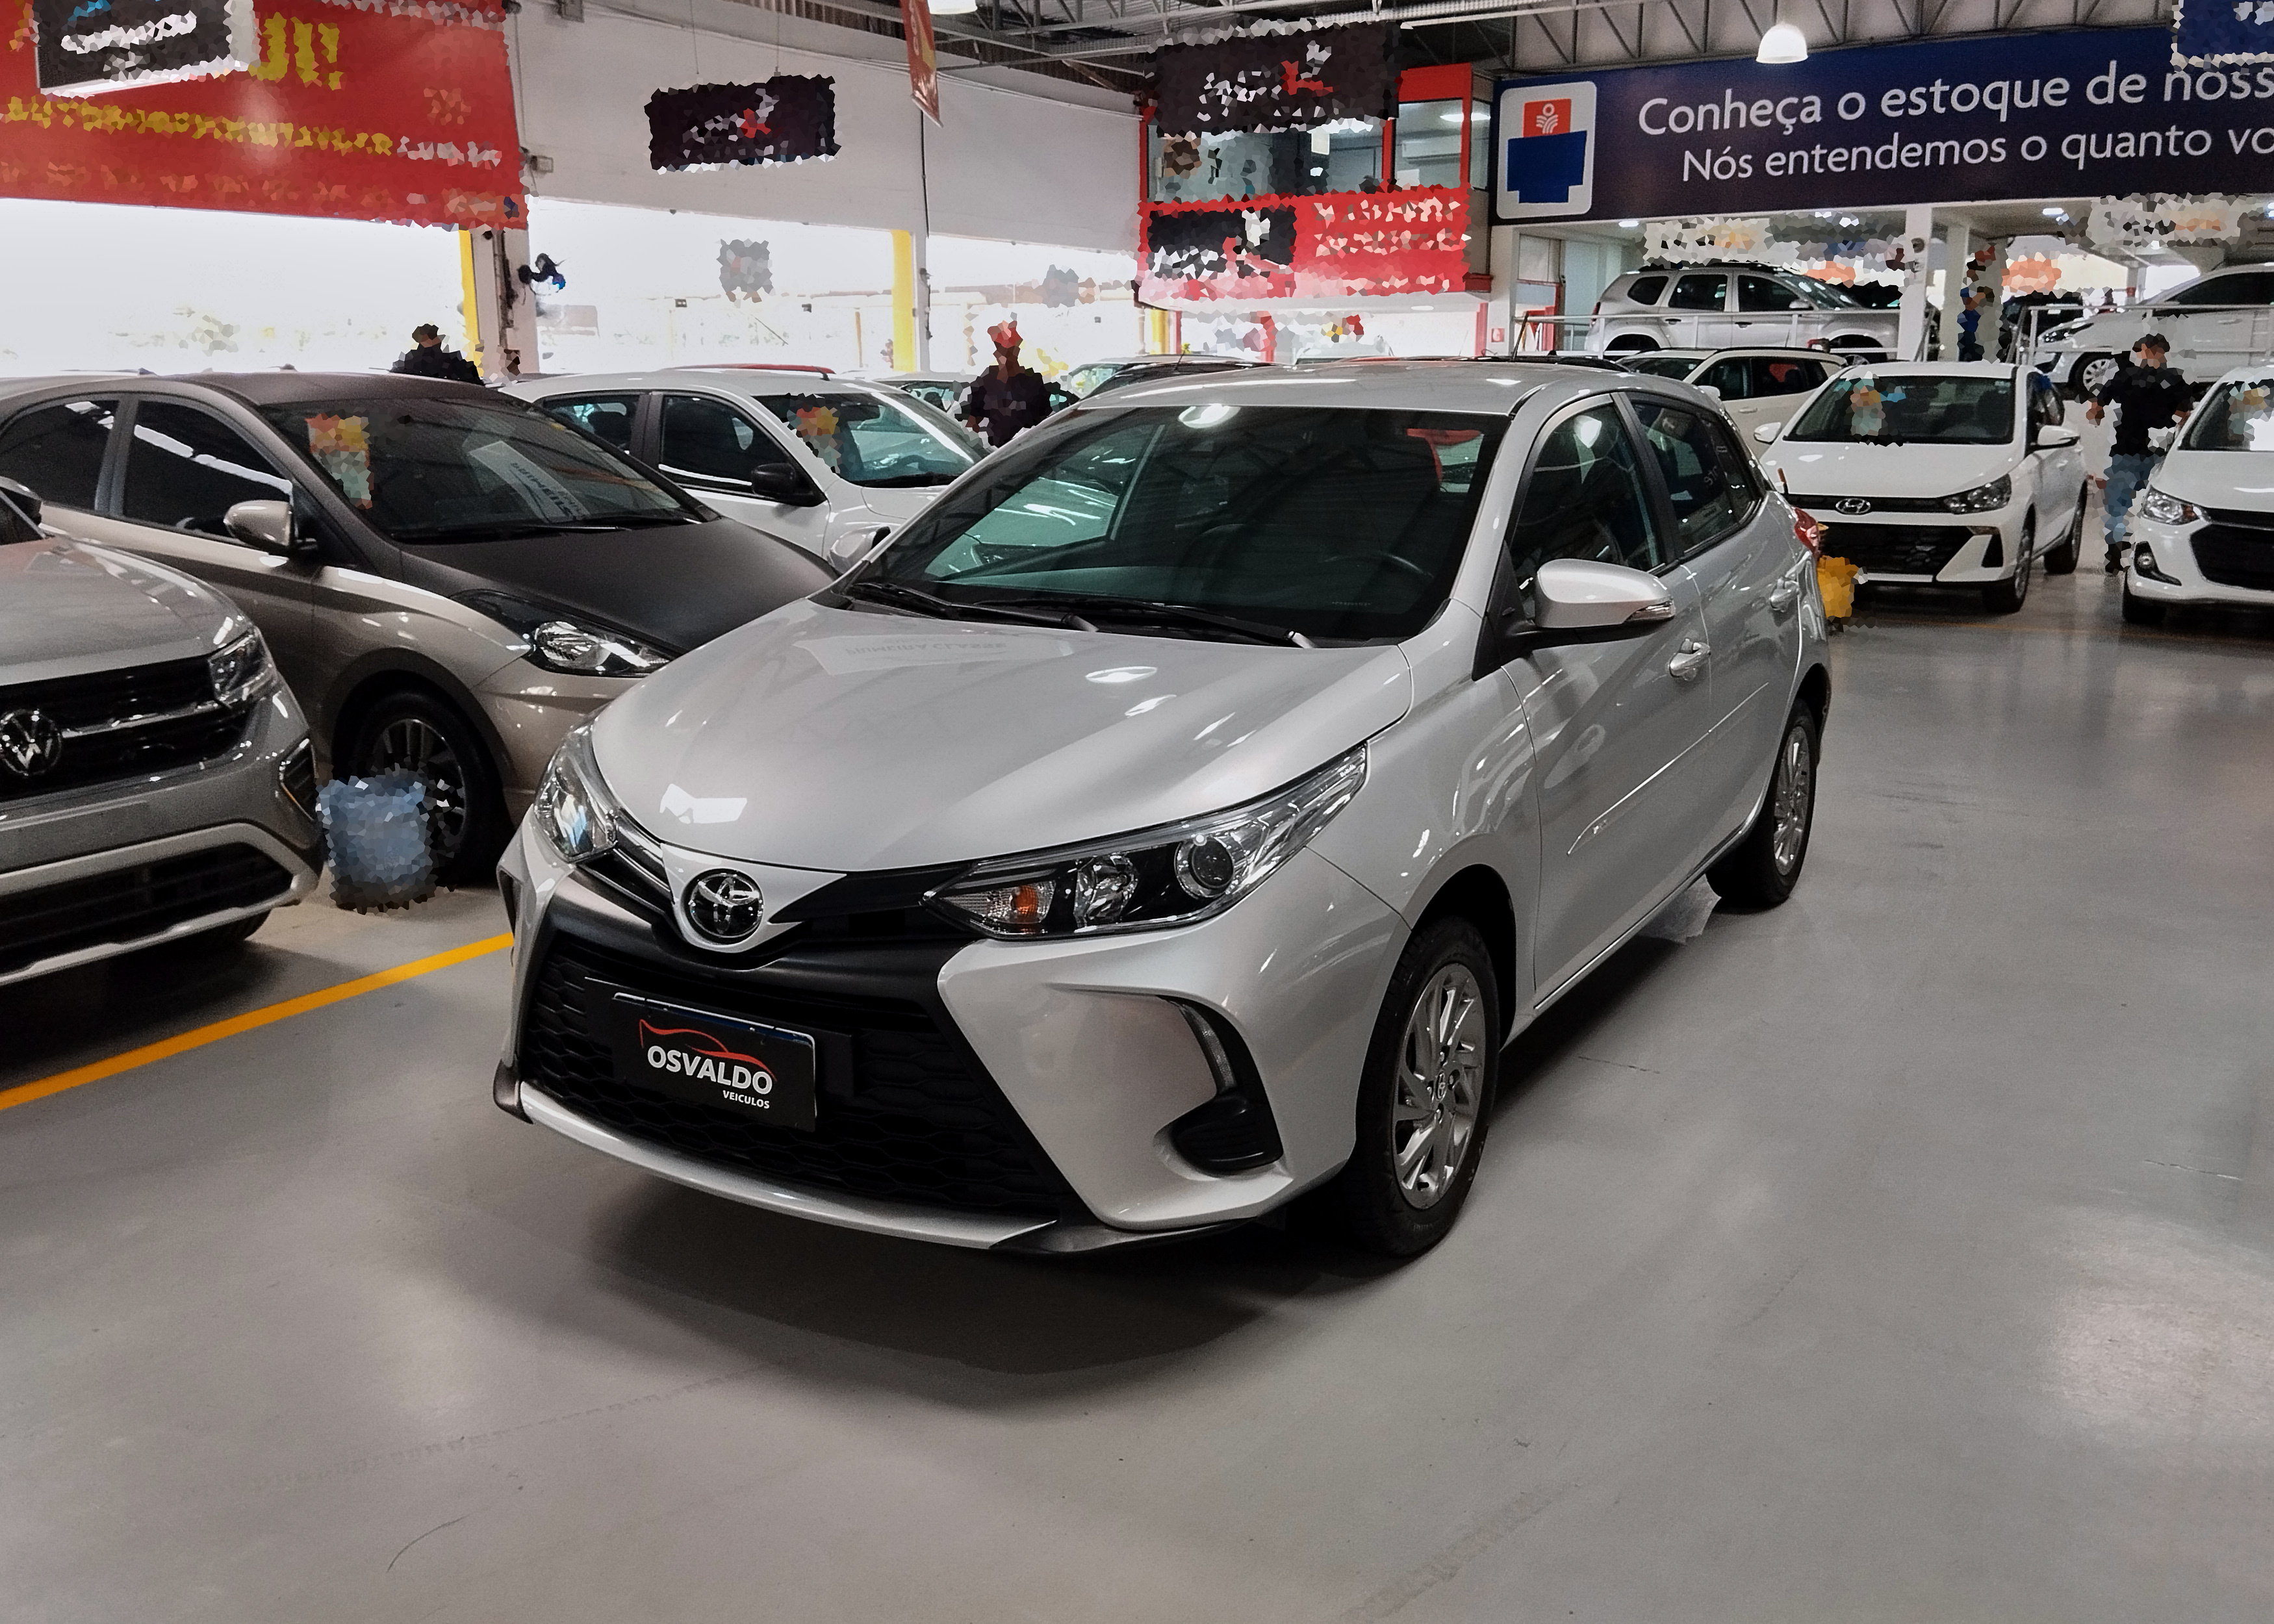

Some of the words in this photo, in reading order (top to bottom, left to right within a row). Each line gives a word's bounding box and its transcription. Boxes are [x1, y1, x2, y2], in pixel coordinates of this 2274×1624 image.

[1639, 88, 1822, 135] Conheça
[1837, 92, 1866, 120] o
[1880, 78, 2070, 122] estoque
[2086, 60, 2147, 105] de
[1683, 146, 1753, 182] Nós
[1765, 133, 2006, 176] entendemos
[2021, 136, 2047, 161] o
[2061, 125, 2212, 170] quanto
[647, 1045, 773, 1095] OSVALDO
[722, 1090, 771, 1110] VEICULOS
